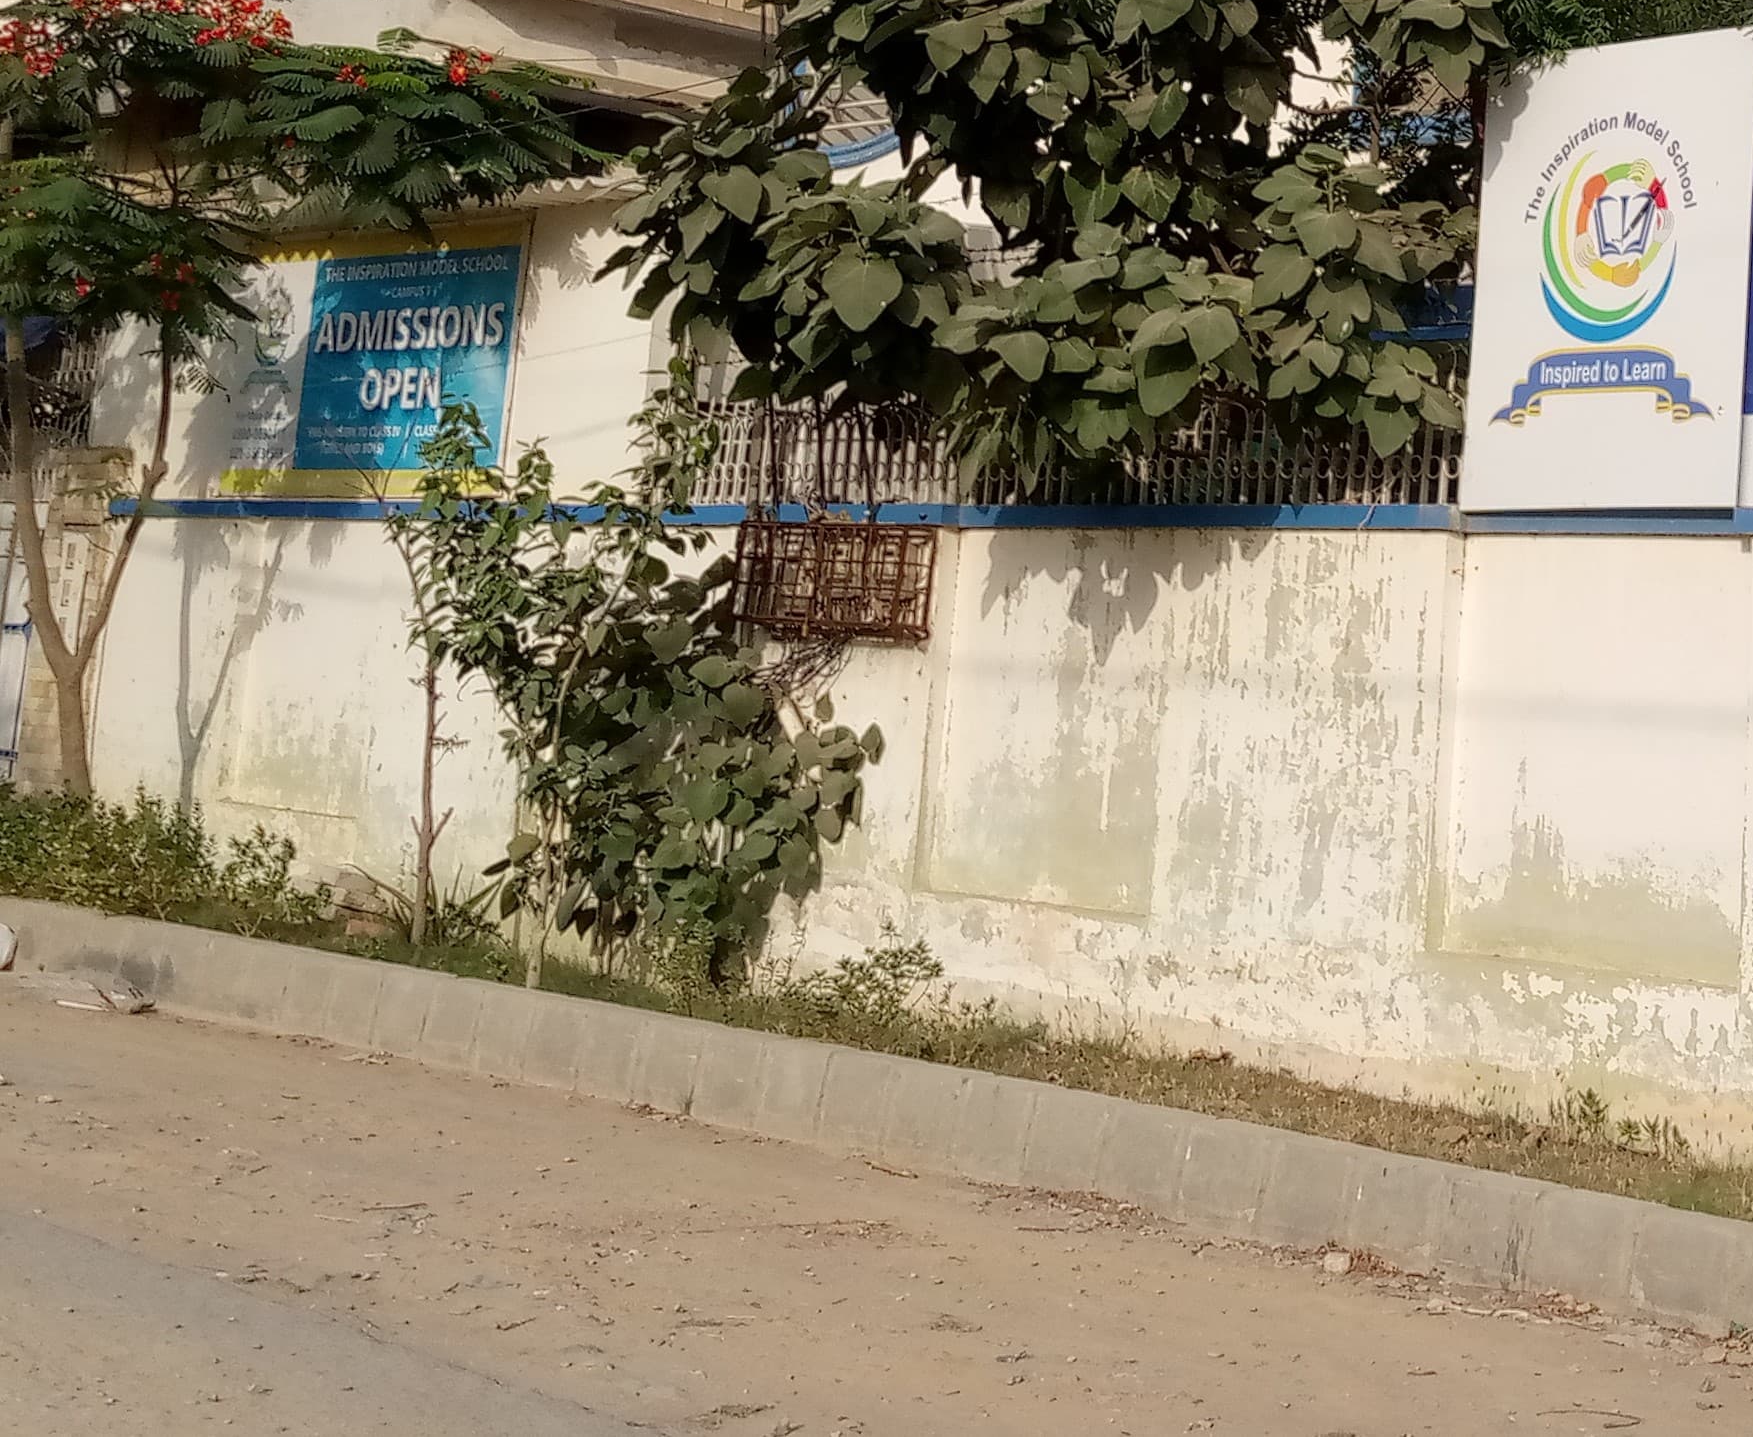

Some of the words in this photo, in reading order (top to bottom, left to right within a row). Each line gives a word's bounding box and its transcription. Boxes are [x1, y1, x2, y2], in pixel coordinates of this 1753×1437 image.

[1524, 186, 1546, 224] The
[1541, 115, 1619, 183] Inspiration
[1623, 111, 1670, 146] Model
[1666, 140, 1698, 210] School
[347, 261, 418, 282] INSPIRATION
[419, 258, 459, 277] MODEL
[461, 254, 509, 274] SCHOOL
[314, 303, 505, 353] ADMISSIONS
[360, 367, 441, 410] OPEN
[1540, 360, 1600, 388] Inspired
[1603, 360, 1619, 382] to
[1623, 359, 1667, 382] Learn
